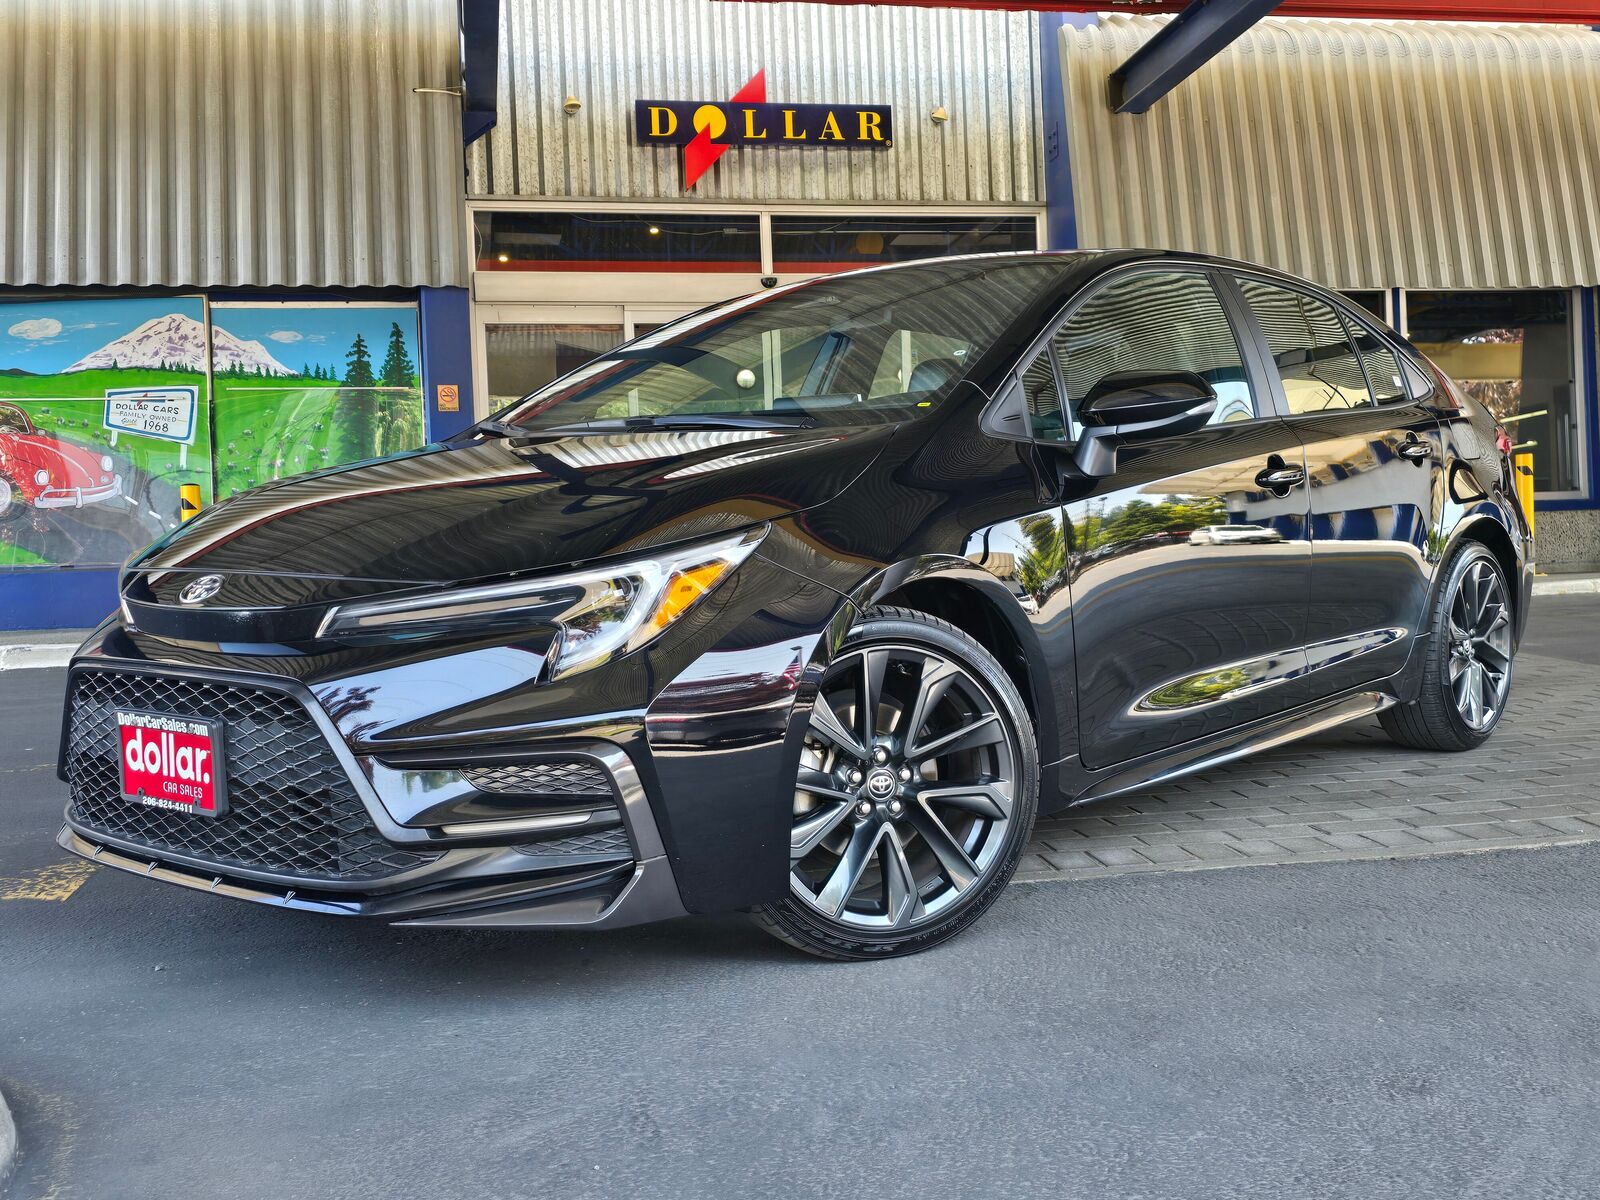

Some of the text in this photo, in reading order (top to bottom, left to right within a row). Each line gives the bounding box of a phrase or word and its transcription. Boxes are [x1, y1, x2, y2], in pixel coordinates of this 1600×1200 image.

[647, 104, 885, 142] DOLLAR
[115, 403, 180, 415] DOLLAR CARS
[119, 411, 177, 423] FAMILY OWNED
[143, 420, 169, 432] 1968
[163, 781, 203, 799] CAR SALES
[142, 796, 193, 814] 206-824-4411
